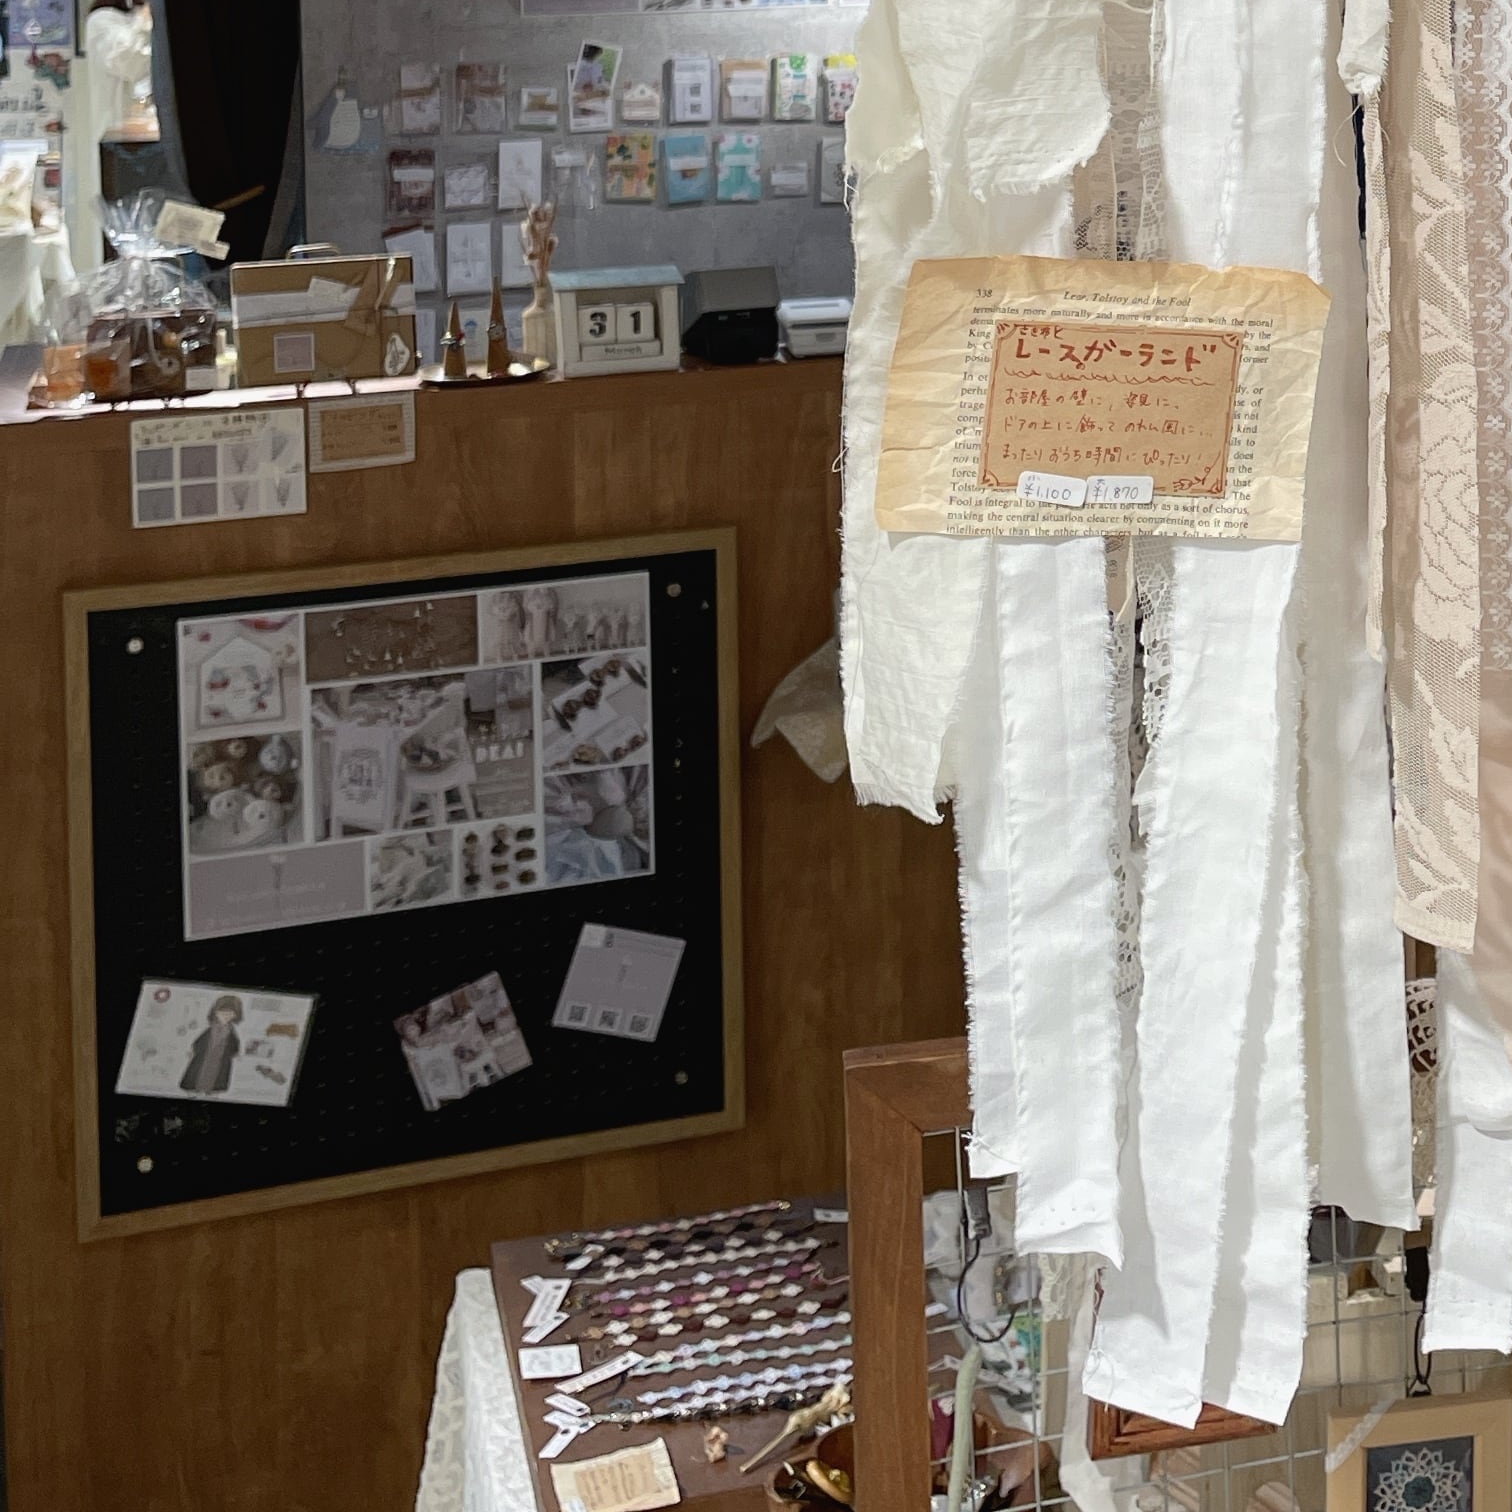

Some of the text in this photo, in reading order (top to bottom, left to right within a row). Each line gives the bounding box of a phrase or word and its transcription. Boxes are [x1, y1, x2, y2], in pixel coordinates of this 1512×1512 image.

[1092, 292, 1129, 305] Tolstoy
[1131, 296, 1149, 306] and
[1152, 296, 1167, 306] the
[1168, 297, 1192, 307] Fool
[1023, 308, 1047, 316] more
[1050, 308, 1090, 319] naturally
[1095, 311, 1112, 320] and
[1116, 313, 1139, 321] more
[1231, 318, 1245, 327] the
[1247, 318, 1274, 328] moral
[968, 328, 992, 340] King
[1254, 343, 1271, 351] and
[1243, 330, 1255, 340] by
[1258, 331, 1272, 340] the
[962, 371, 974, 381] In
[1252, 387, 1264, 395] or
[1250, 398, 1262, 407] of
[1243, 411, 1259, 420] not
[955, 426, 967, 435] of
[1246, 438, 1256, 447] to
[1236, 424, 1258, 434] kind
[952, 455, 969, 463] not
[1238, 464, 1253, 474] the
[951, 467, 1252, 487] force that
[1023, 482, 1072, 501] ¥1,100
[1232, 491, 1251, 501] The
[949, 496, 972, 506] Fool
[974, 498, 983, 506] is
[985, 497, 1022, 508] integral
[1025, 499, 1036, 508] to
[1161, 503, 1171, 511] as
[1182, 504, 1200, 513] sort
[1202, 504, 1213, 514] of
[1215, 505, 1250, 516] chorus,
[947, 511, 1249, 529] making the central situation clearer by commenting on it more
[1008, 526, 1030, 536] than
[1034, 526, 1050, 536] the
[1053, 527, 1078, 537] other
